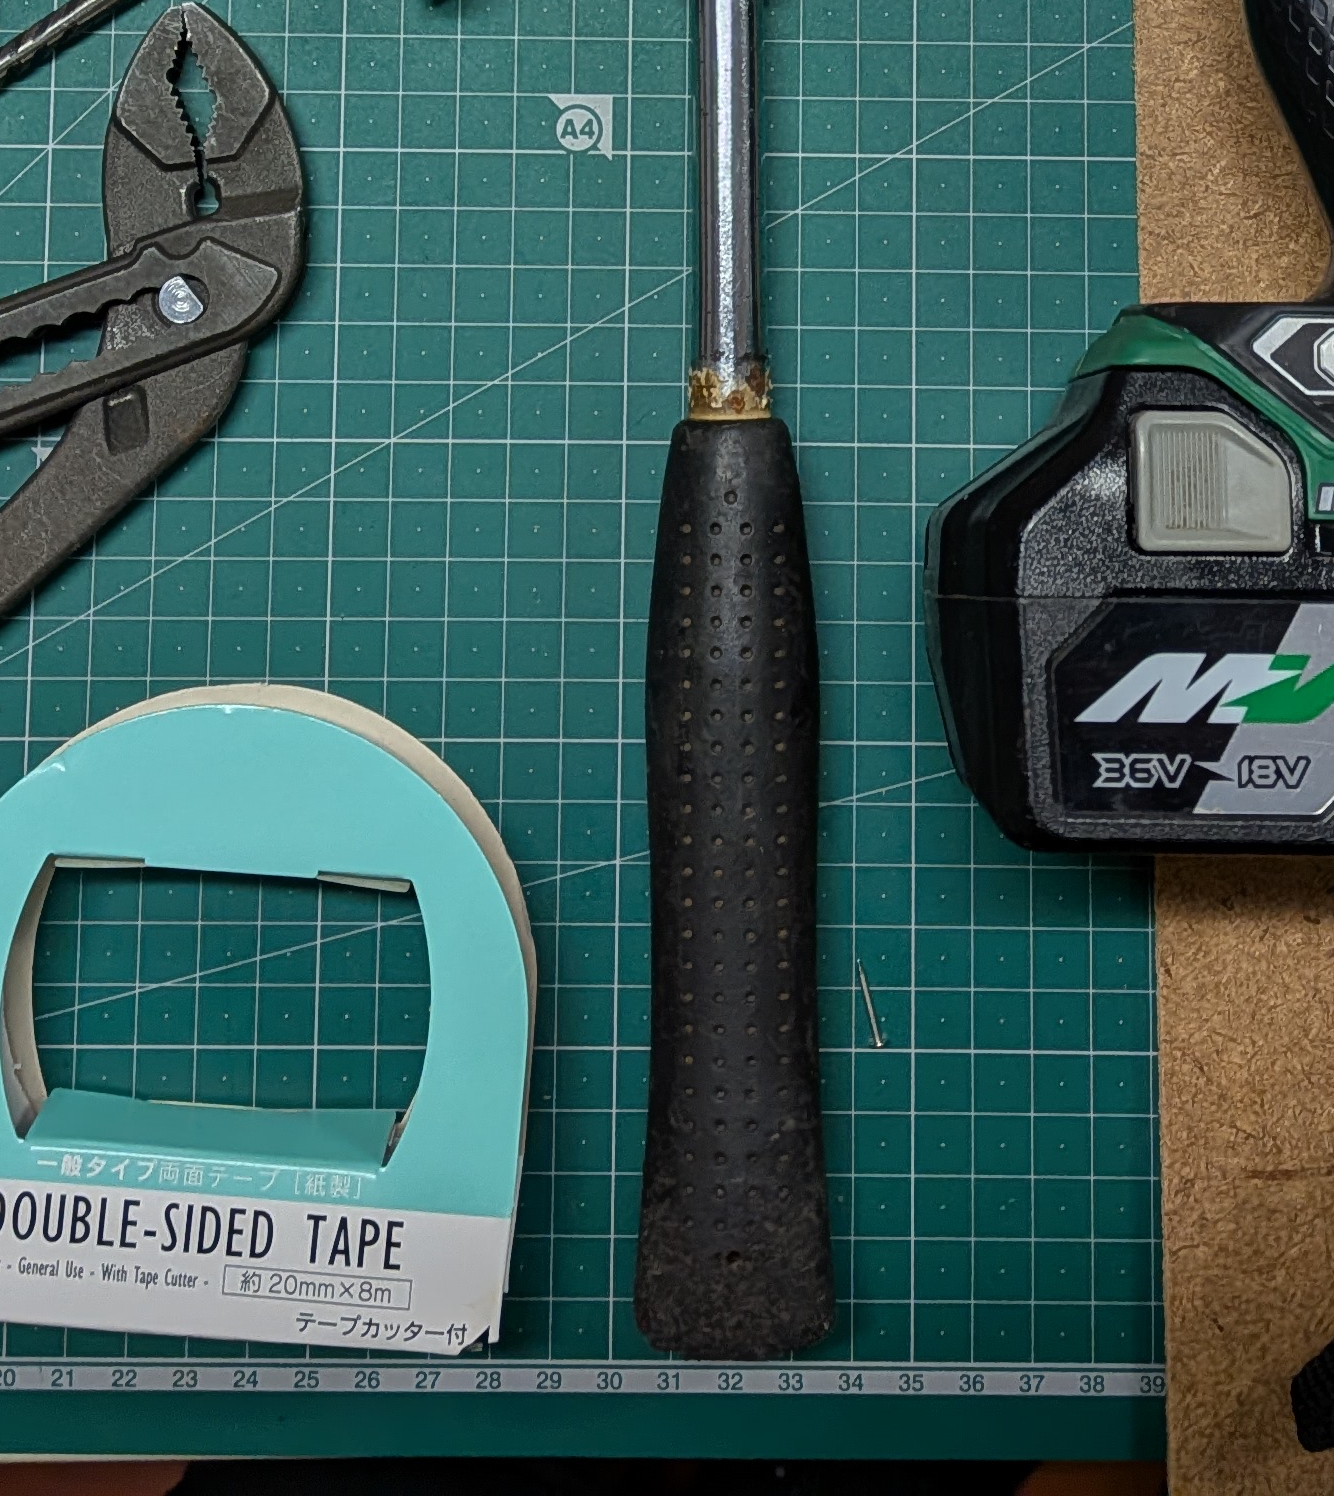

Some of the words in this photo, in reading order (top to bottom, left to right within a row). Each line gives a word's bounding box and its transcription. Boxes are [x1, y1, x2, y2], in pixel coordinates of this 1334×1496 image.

[560, 118, 595, 140] A4
[1092, 753, 1195, 789] 36V
[1237, 755, 1312, 789] 18V
[36, 1156, 277, 1191] 一般タイプ両面テープ
[307, 1215, 404, 1271] TAPE
[18, 1257, 60, 1279] General
[66, 1261, 84, 1279] Use
[101, 1263, 127, 1284] With
[133, 1265, 160, 1288] Tape
[164, 1267, 199, 1289] Cutter
[295, 1312, 468, 1347] テープカッター付
[51, 1368, 75, 1387] 21
[112, 1368, 137, 1387] 22
[172, 1368, 199, 1387] 23
[233, 1368, 258, 1388] 24
[294, 1369, 320, 1388] 25
[354, 1369, 381, 1389] 26
[415, 1369, 441, 1389] 27
[475, 1370, 502, 1390] 28
[536, 1371, 562, 1391] 29
[596, 1371, 622, 1391] 30
[656, 1371, 681, 1391] 31
[717, 1372, 743, 1391] 32
[778, 1372, 803, 1391] 33
[838, 1372, 864, 1392] 34
[898, 1372, 924, 1392] 35
[958, 1372, 985, 1392] 36
[1018, 1373, 1044, 1392] 37
[1079, 1373, 1105, 1392] 38
[1139, 1373, 1166, 1393] 39
